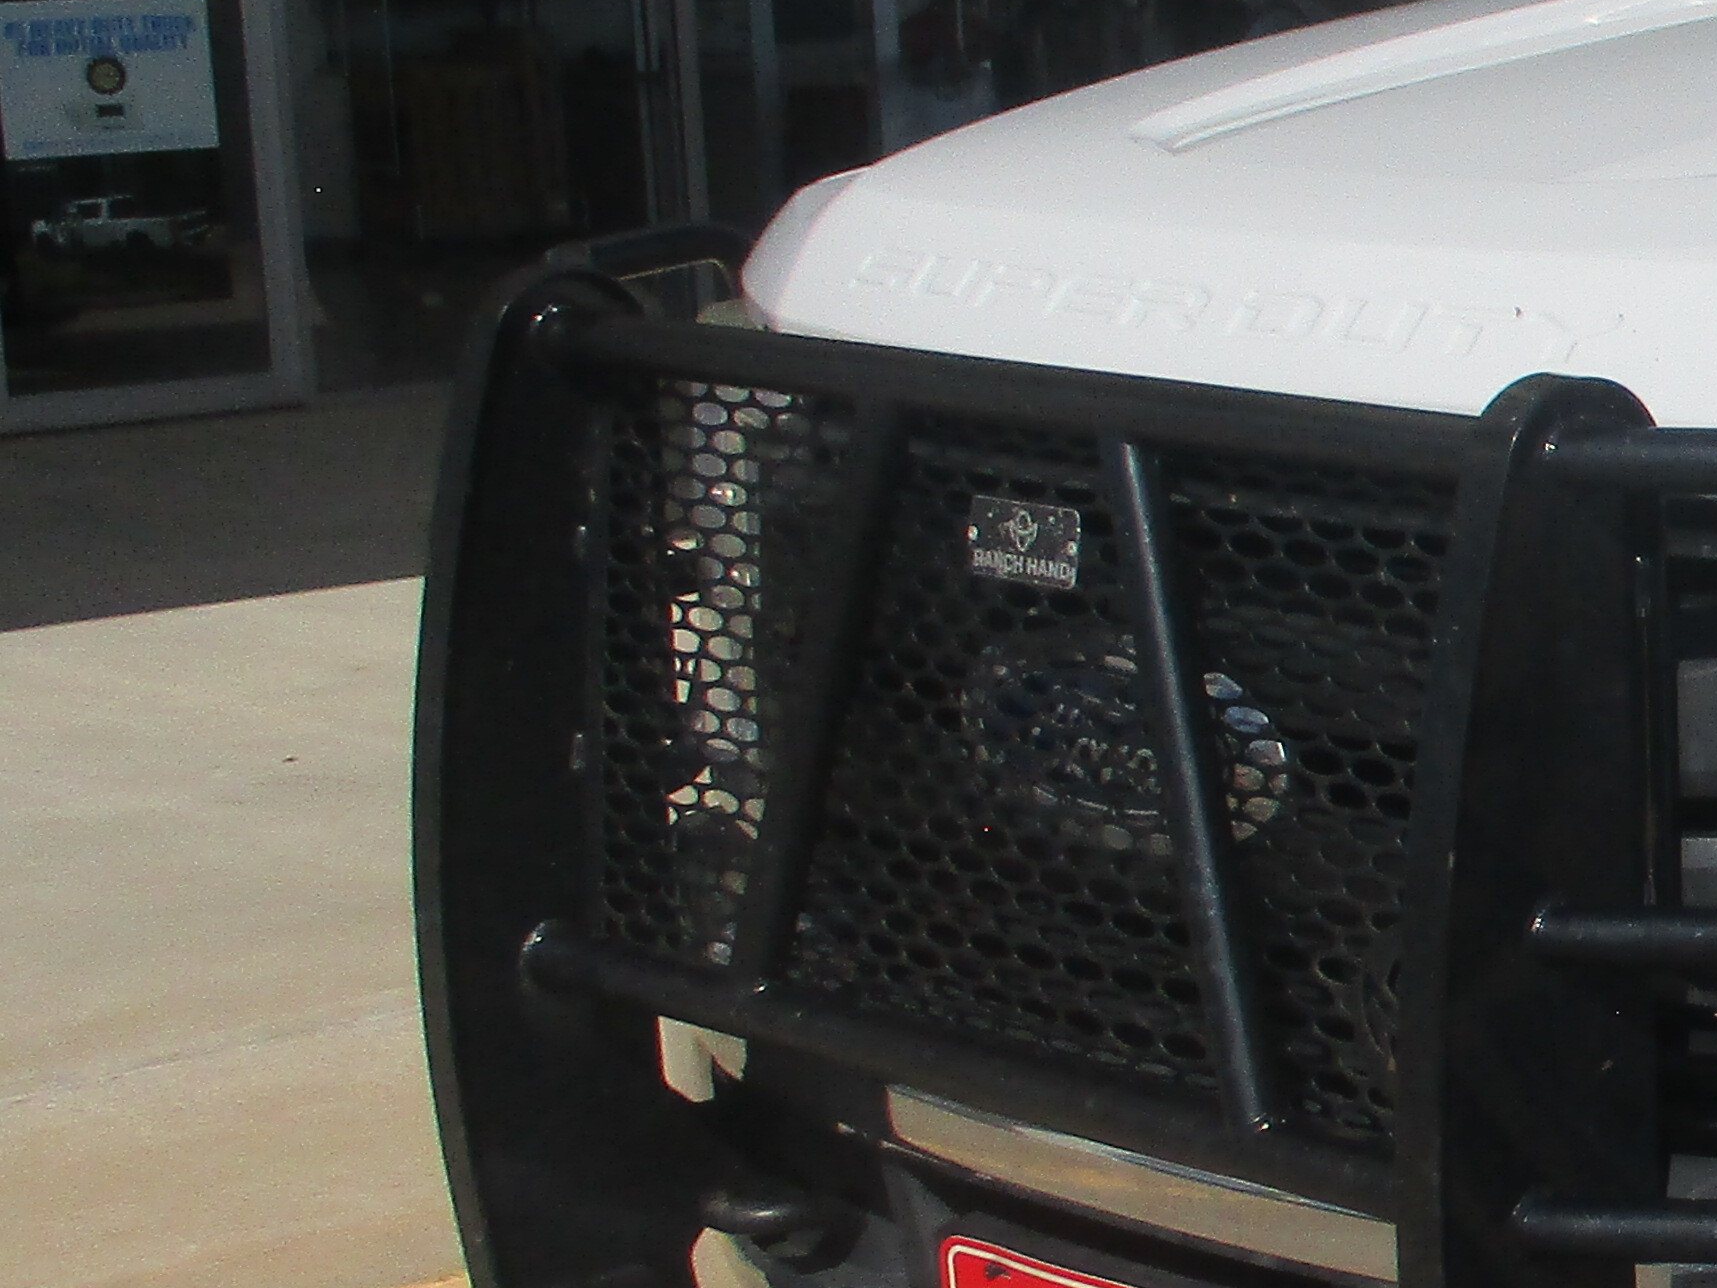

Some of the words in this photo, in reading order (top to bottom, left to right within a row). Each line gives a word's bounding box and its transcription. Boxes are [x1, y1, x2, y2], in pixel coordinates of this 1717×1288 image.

[848, 250, 1213, 332] SUPER
[1226, 287, 1627, 366] DUTY
[973, 550, 1024, 575] RANCH
[1026, 557, 1072, 581] HAND
